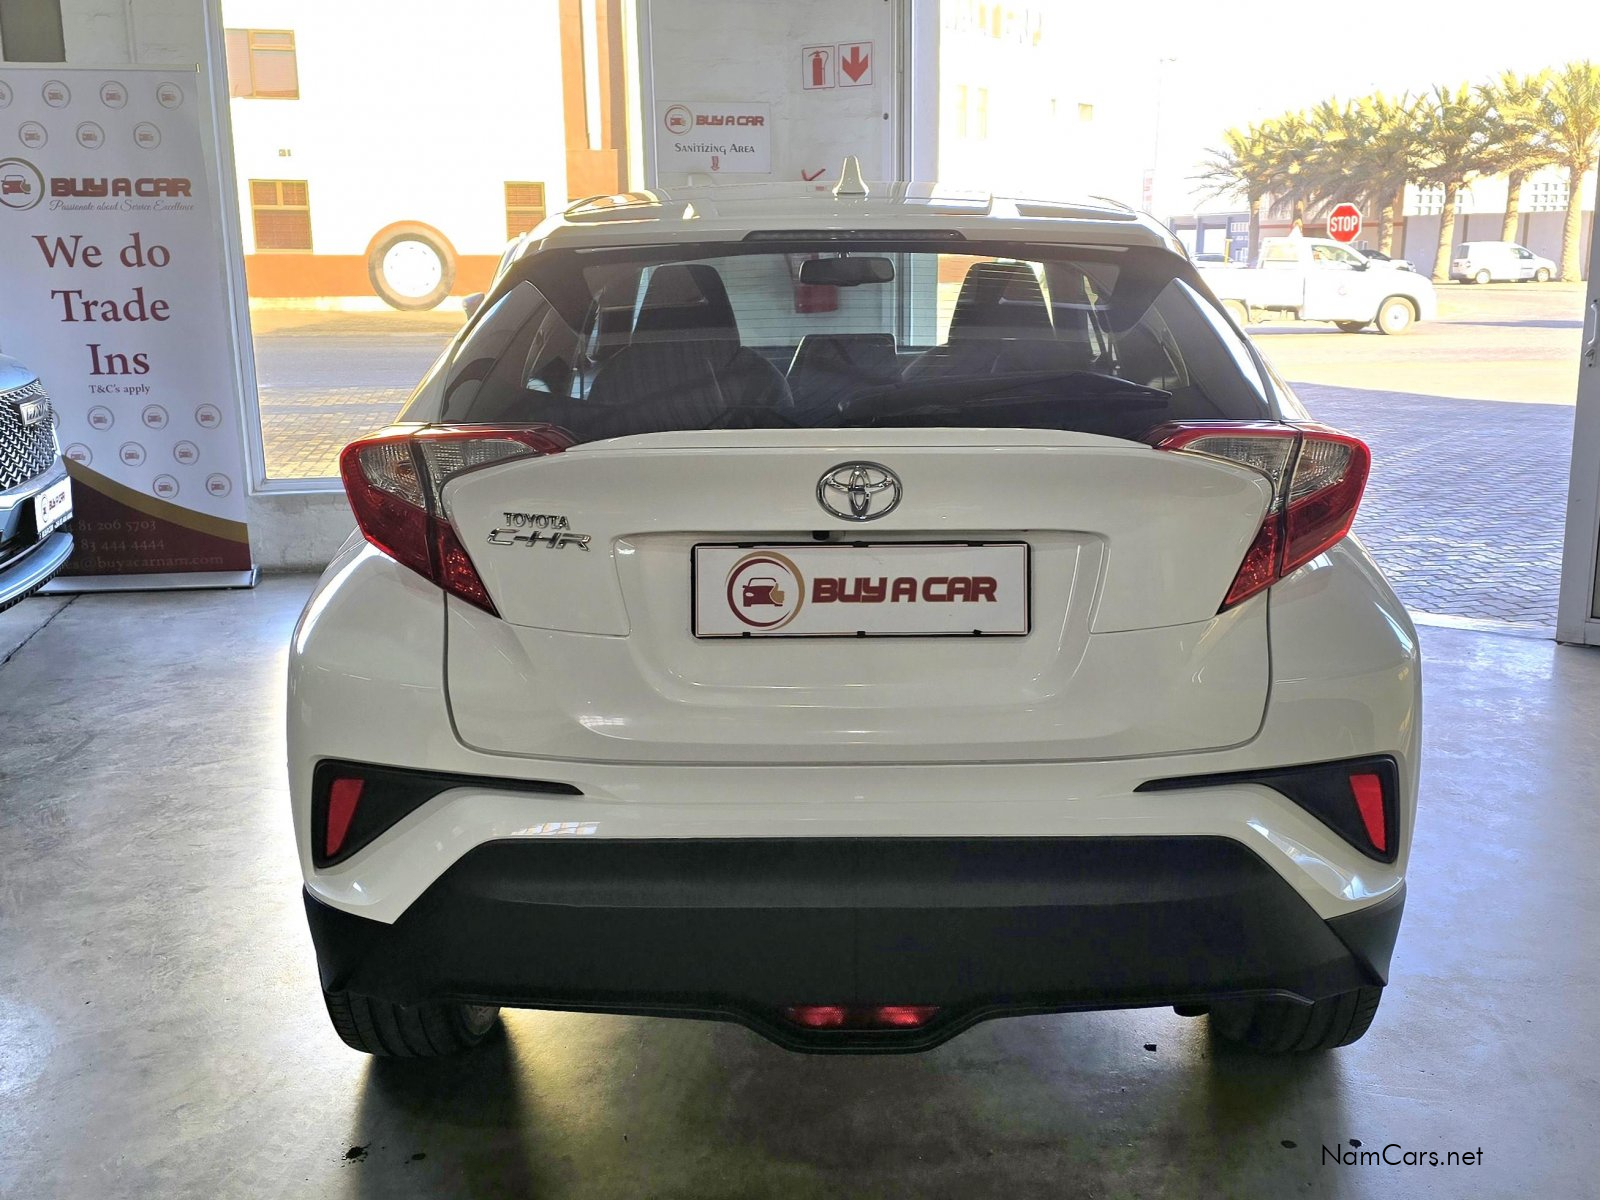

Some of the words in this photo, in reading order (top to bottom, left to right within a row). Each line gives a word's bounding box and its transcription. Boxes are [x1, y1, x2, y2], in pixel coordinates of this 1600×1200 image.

[696, 114, 724, 126] BUY
[725, 115, 736, 126] A
[737, 115, 765, 126] CAR
[50, 177, 108, 198] BUY
[111, 177, 132, 197] A
[134, 177, 193, 198] CAR
[49, 199, 95, 211] Passionate
[96, 199, 118, 211] about
[120, 199, 152, 211] Service
[152, 199, 194, 212] Excellence
[1330, 215, 1358, 232] STOP
[31, 234, 103, 268] We
[119, 231, 171, 268] do
[51, 286, 171, 322] Trade
[86, 343, 150, 375] Ins
[123, 383, 151, 395] apply
[98, 519, 122, 531] 206
[503, 512, 571, 530] TOYOTA
[811, 577, 889, 604] BUY
[890, 577, 918, 603] A
[922, 576, 998, 603] CAR
